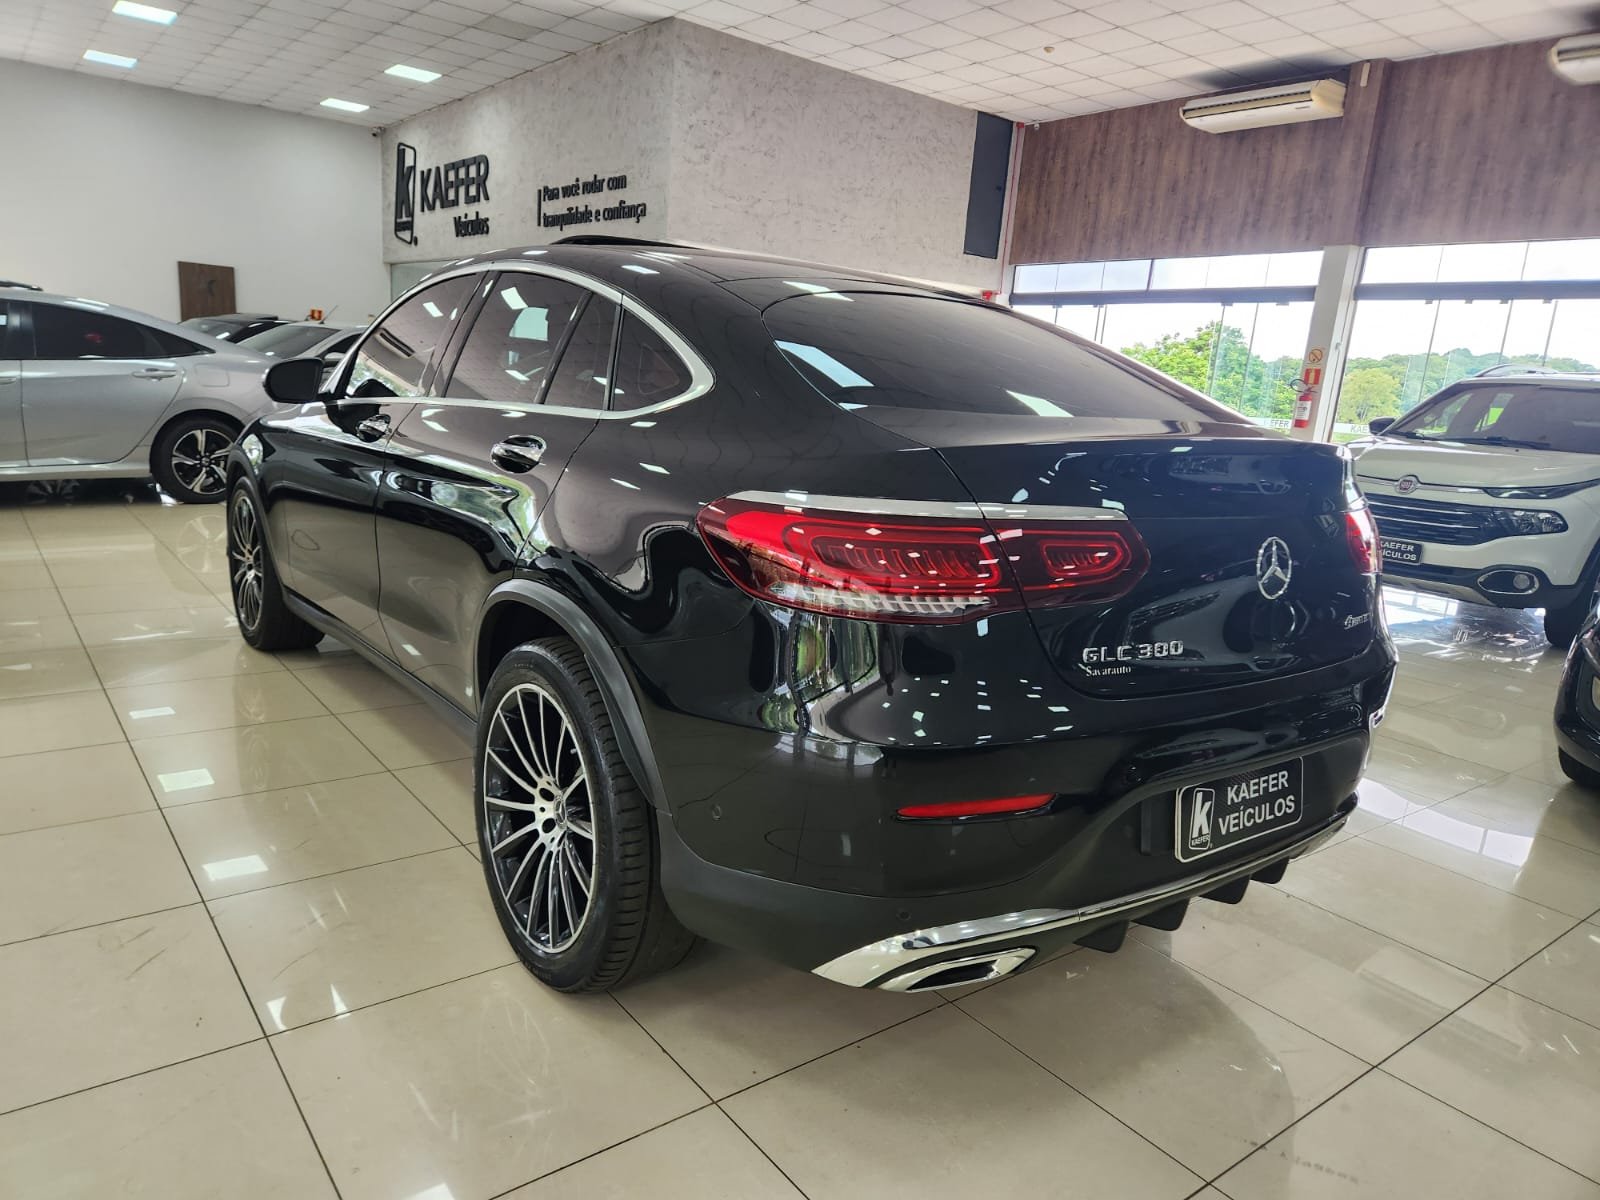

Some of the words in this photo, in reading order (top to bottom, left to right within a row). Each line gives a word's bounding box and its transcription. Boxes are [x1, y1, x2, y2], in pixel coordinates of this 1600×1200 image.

[420, 154, 490, 213] KAEFER
[543, 186, 560, 202] Para
[561, 177, 580, 198] você
[582, 174, 605, 194] rodar
[607, 175, 627, 191] com
[453, 211, 490, 237] Veículos
[595, 209, 601, 222] e
[602, 200, 647, 224] confiança
[1082, 646, 1133, 663] GLC
[1138, 640, 1184, 659] 300
[1085, 665, 1132, 677] Savarauto
[1227, 770, 1289, 806] KAEFER
[1218, 795, 1295, 836] VEÍCULOS
